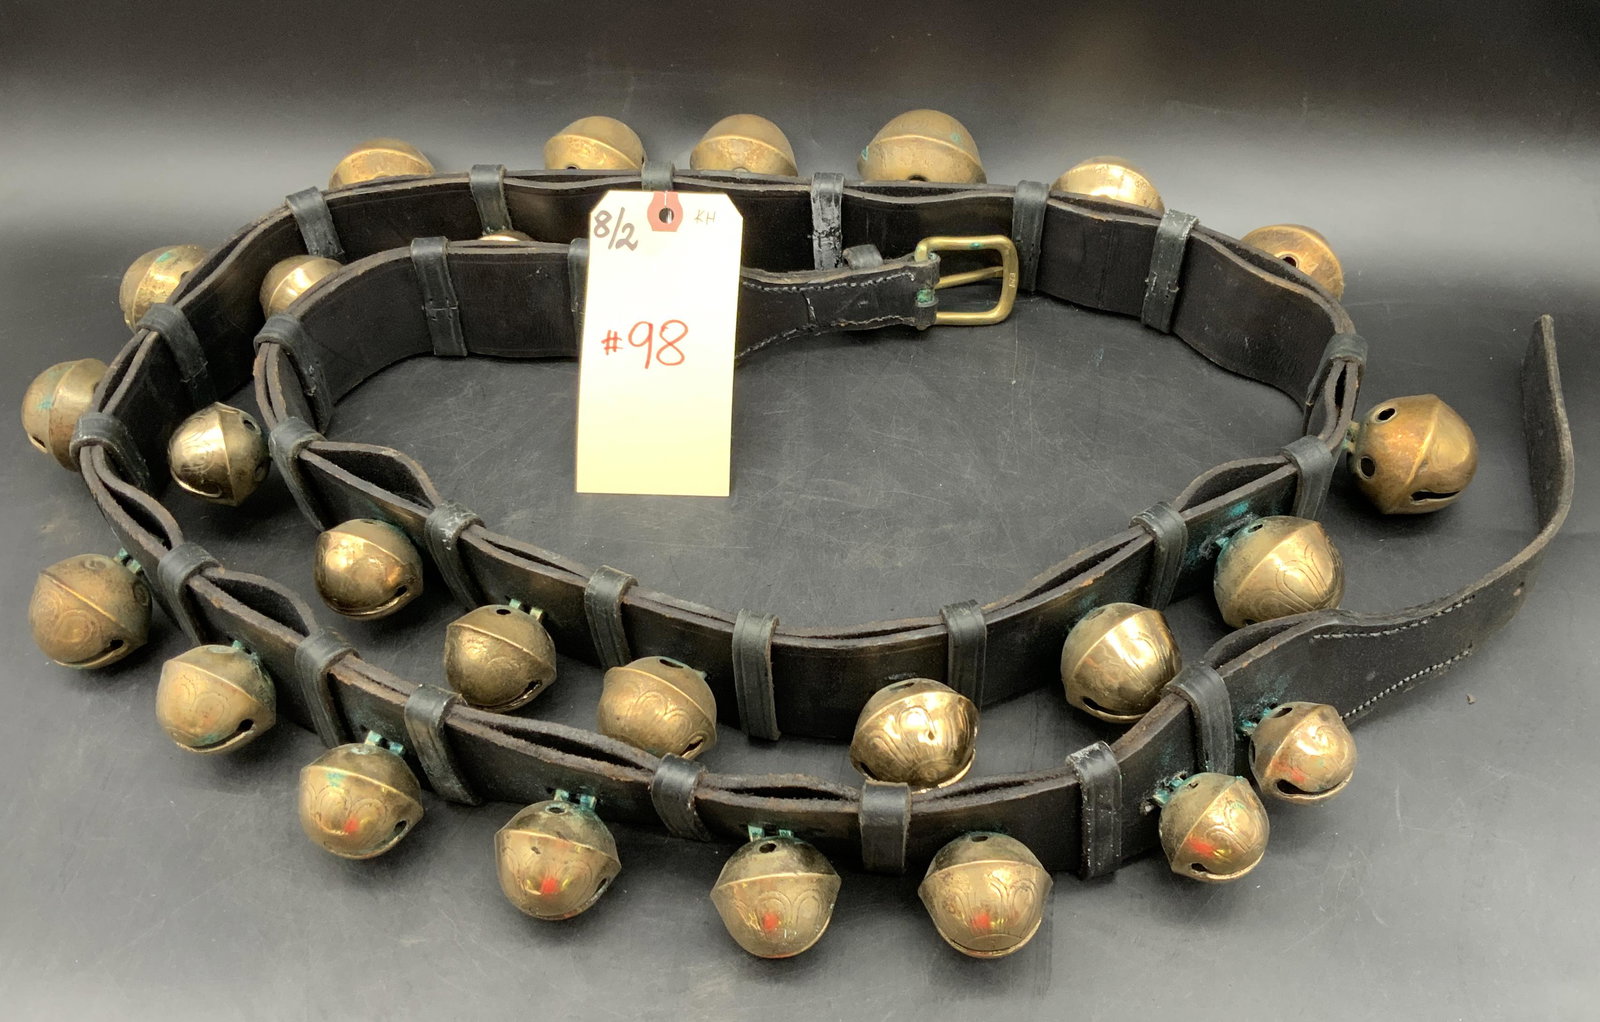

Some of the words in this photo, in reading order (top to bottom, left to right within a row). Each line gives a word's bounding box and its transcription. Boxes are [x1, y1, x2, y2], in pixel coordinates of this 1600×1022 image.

[593, 206, 638, 251] 8/2
[693, 209, 717, 225] KH
[601, 319, 689, 369] #98
